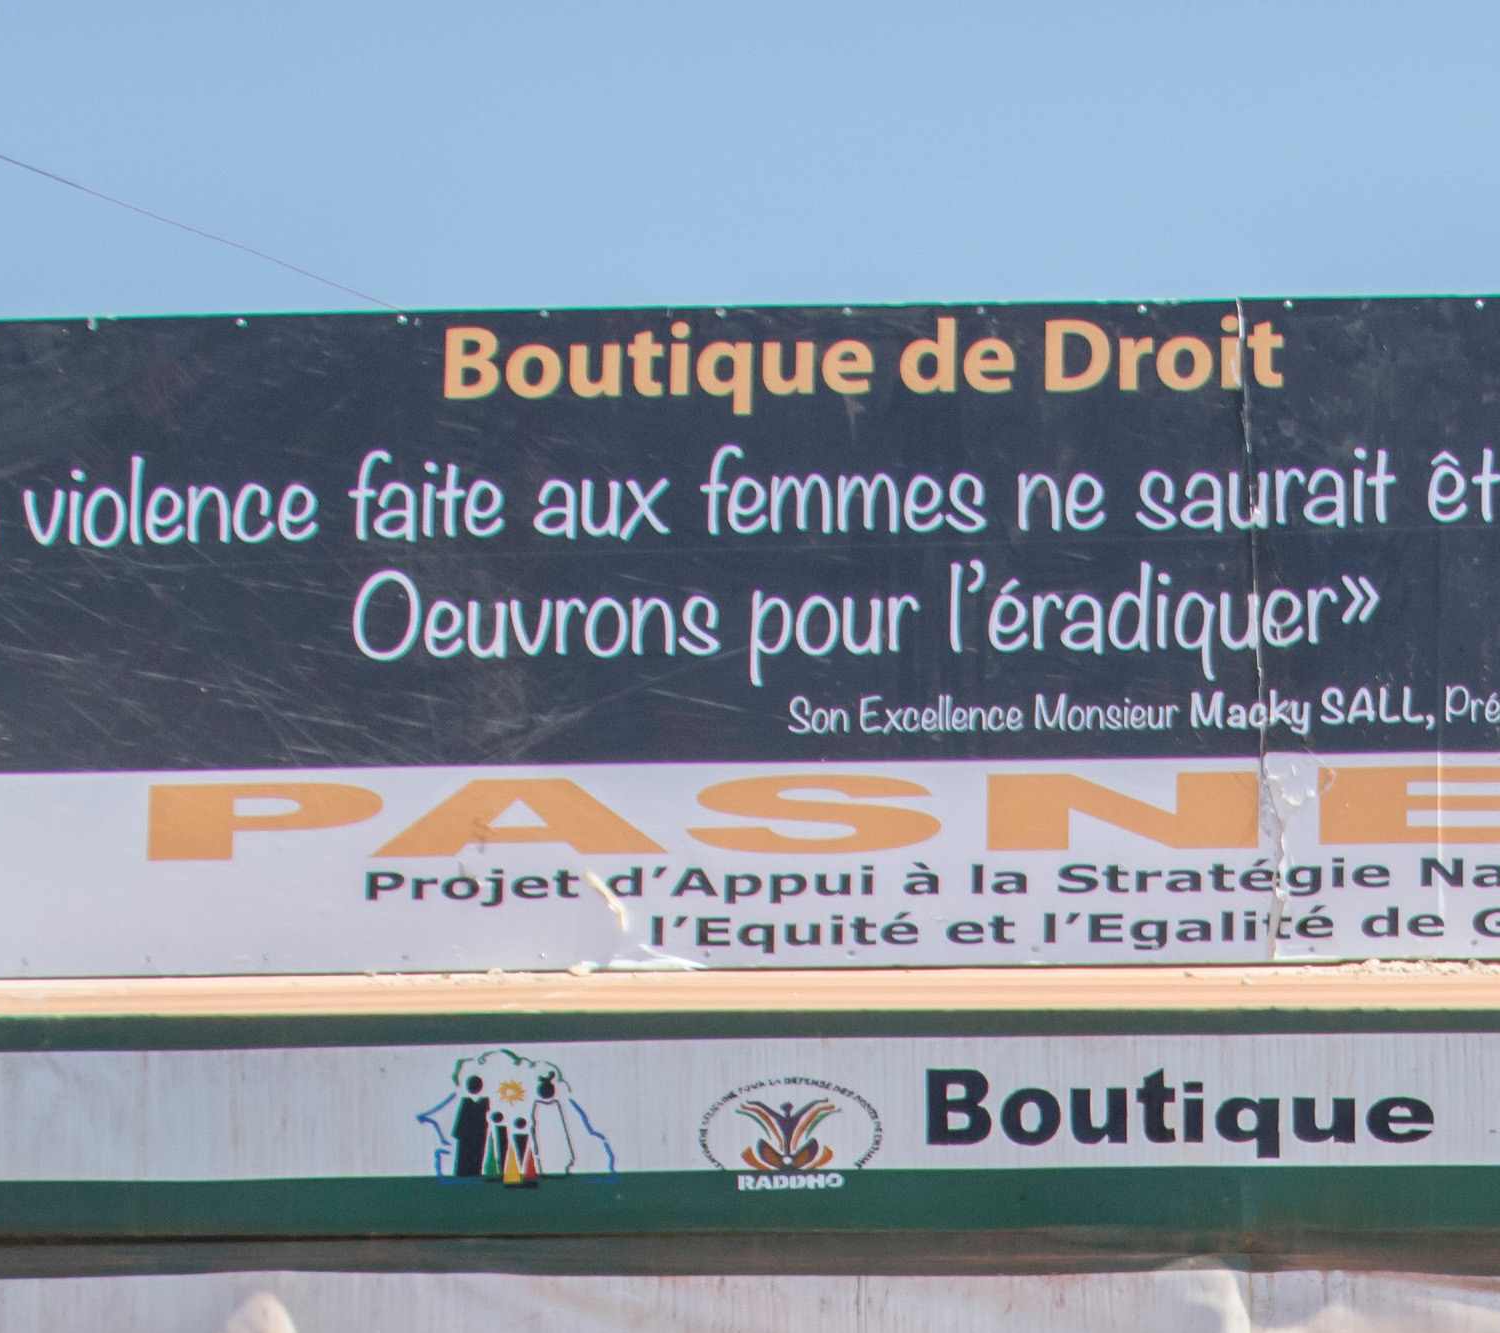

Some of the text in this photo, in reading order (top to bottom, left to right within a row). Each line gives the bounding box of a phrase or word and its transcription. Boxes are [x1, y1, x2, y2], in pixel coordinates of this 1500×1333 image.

[444, 316, 1283, 414] Boutique de Droit
[23, 456, 317, 547] violence
[348, 450, 503, 541] faite
[533, 478, 669, 540] aux
[700, 445, 986, 534] femmes
[1018, 473, 1105, 531] ne
[1136, 448, 1396, 532] saurait
[353, 560, 1379, 686] Oeuvrons pour l'éradiquer»
[788, 696, 849, 733] Son
[860, 694, 1023, 733] Excellence
[1035, 693, 1178, 730] Monsieur
[1191, 687, 1310, 736] Macky
[1321, 686, 1434, 729] SALL,
[366, 869, 579, 907] Projet
[607, 864, 876, 908] d'Appui
[904, 863, 939, 895] à
[972, 864, 1027, 894] la
[1057, 858, 1389, 900] Stratégie
[652, 912, 918, 954] l'Equité
[946, 916, 1015, 944] et
[1044, 905, 1333, 950] l'Egalité
[1362, 907, 1444, 937] de
[926, 1069, 1434, 1158] Boutique
[737, 1172, 845, 1192] RADDHO
